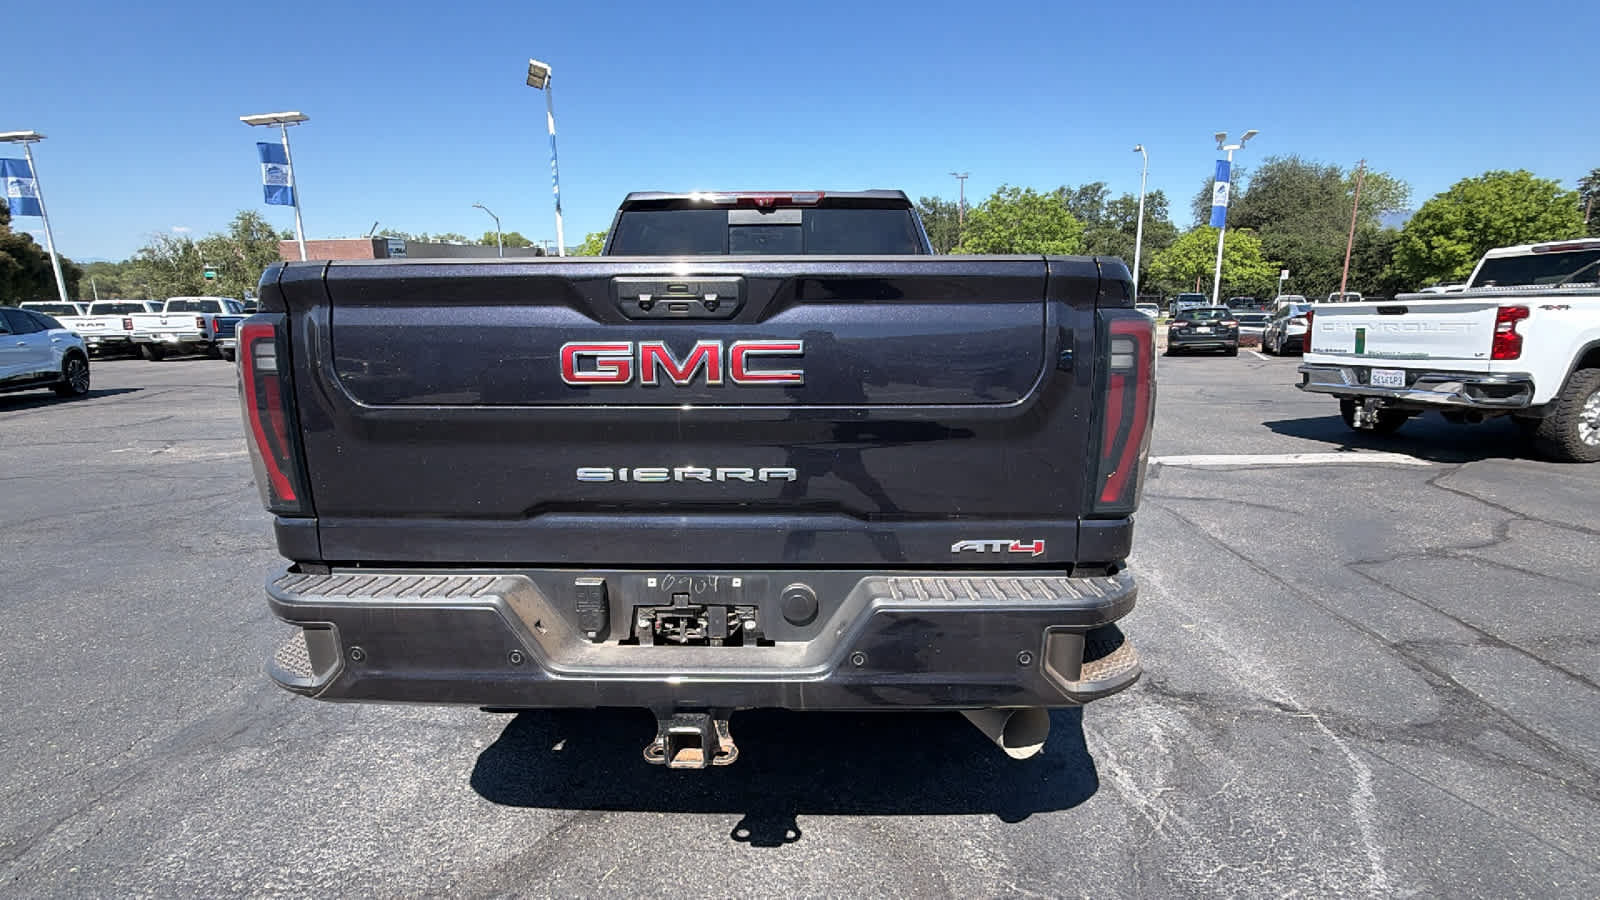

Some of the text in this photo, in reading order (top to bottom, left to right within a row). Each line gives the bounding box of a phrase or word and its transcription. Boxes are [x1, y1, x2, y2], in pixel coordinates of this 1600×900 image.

[560, 340, 805, 385] GMC
[576, 466, 798, 483] SIERRA
[951, 539, 1046, 557] AT4
